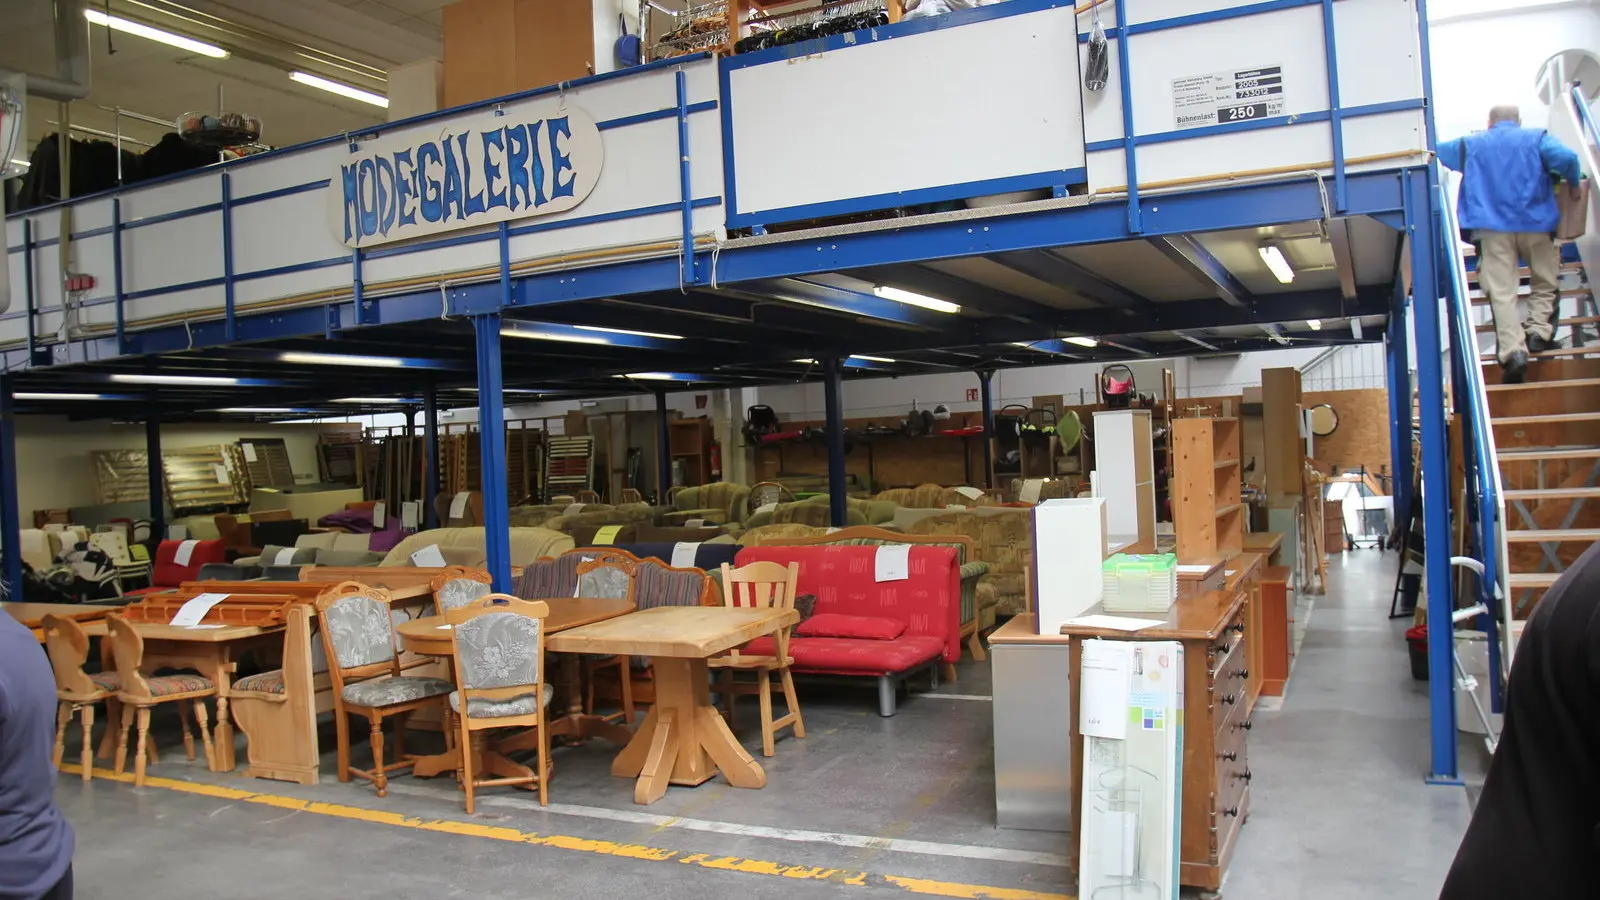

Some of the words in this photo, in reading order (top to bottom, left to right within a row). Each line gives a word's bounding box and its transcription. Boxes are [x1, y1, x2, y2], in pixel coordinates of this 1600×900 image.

[1238, 79, 1259, 89] 2005
[1239, 88, 1269, 98] 733012
[1229, 105, 1255, 120] 250
